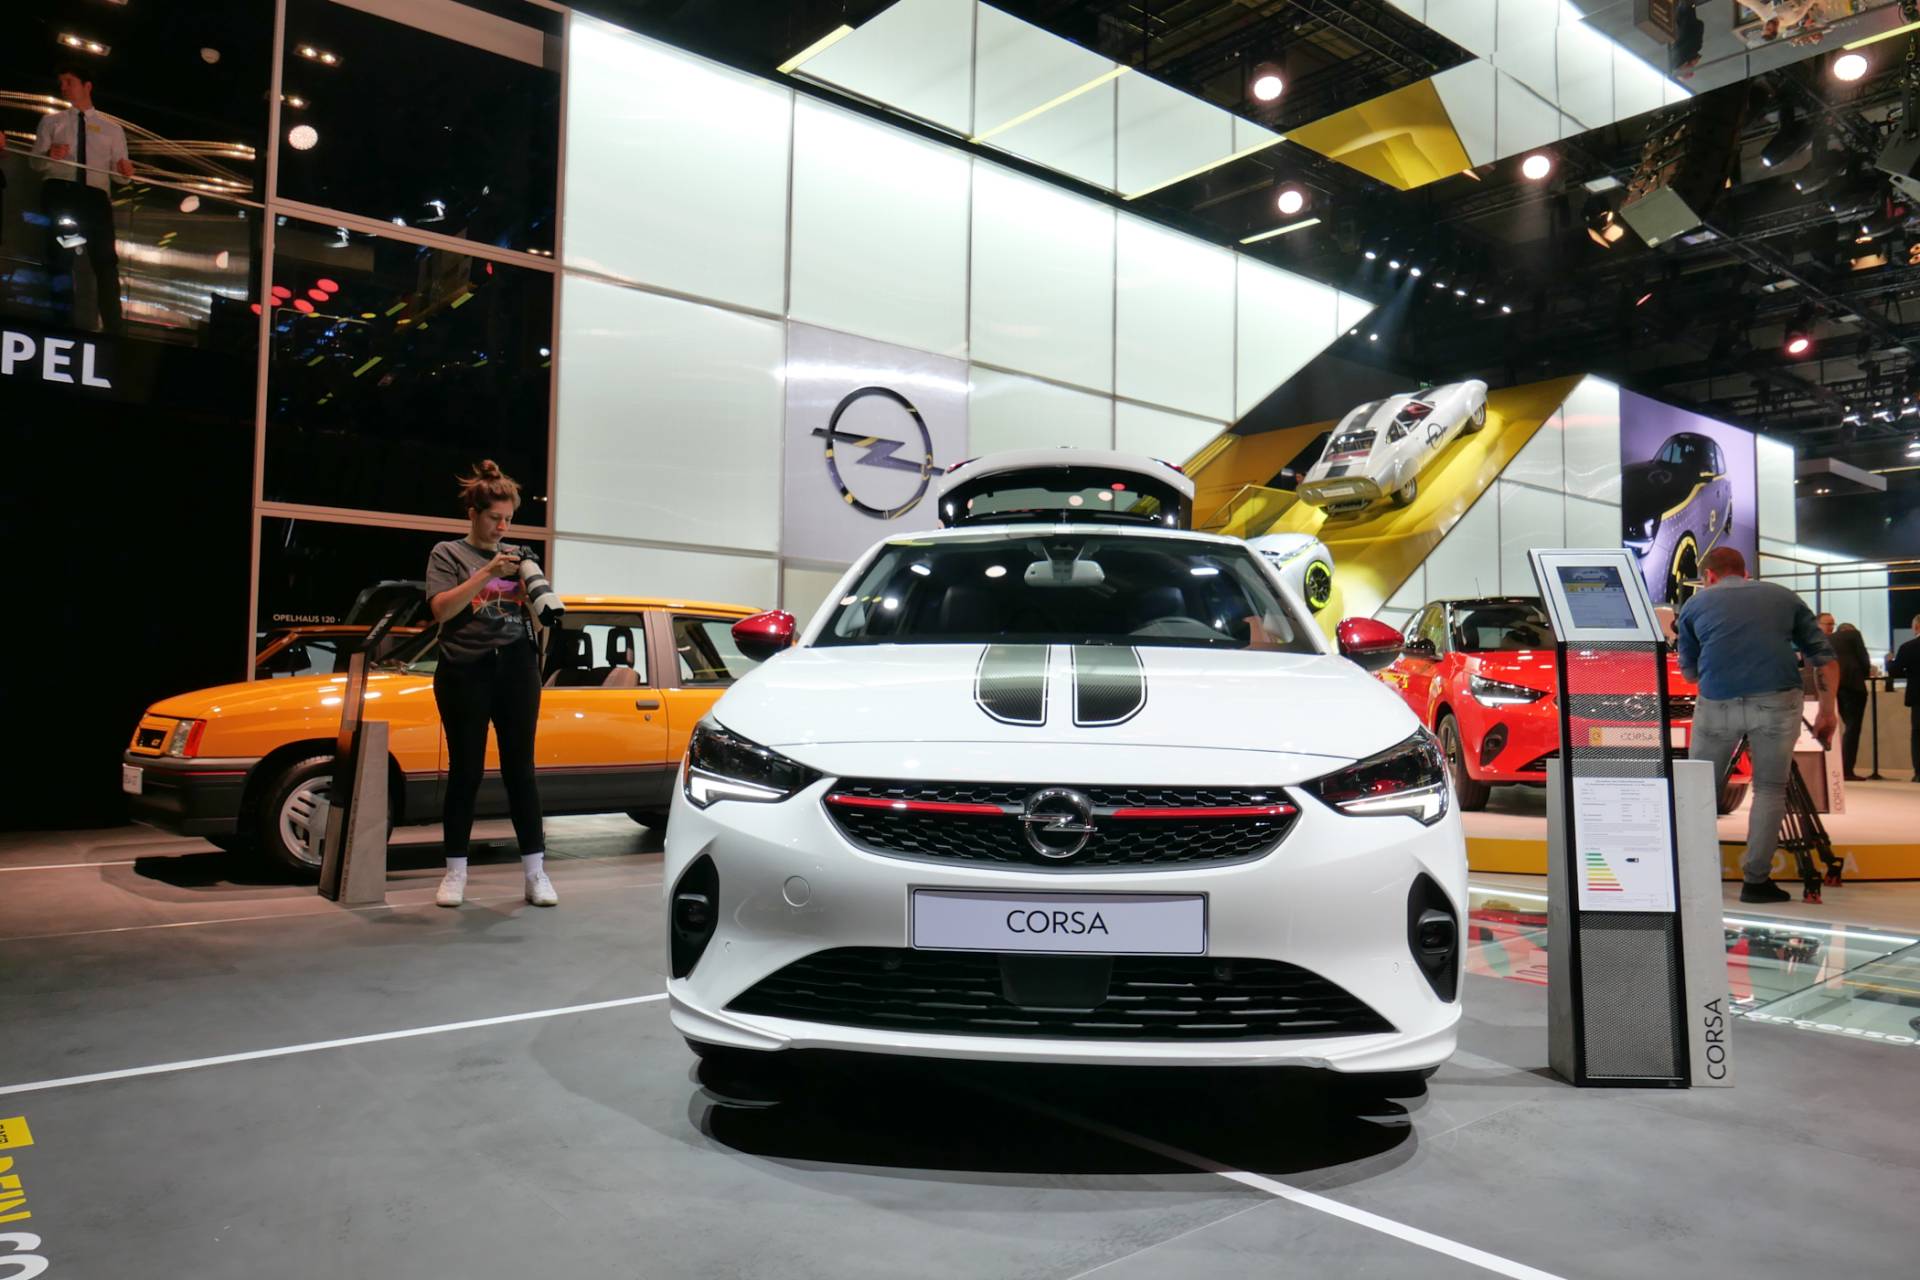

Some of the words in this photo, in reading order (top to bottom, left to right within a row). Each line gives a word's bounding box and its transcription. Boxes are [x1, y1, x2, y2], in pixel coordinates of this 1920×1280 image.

[272, 613, 320, 623] OPELHAUS
[1006, 909, 1109, 935] CORSA
[1703, 998, 1727, 1080] CORSA
